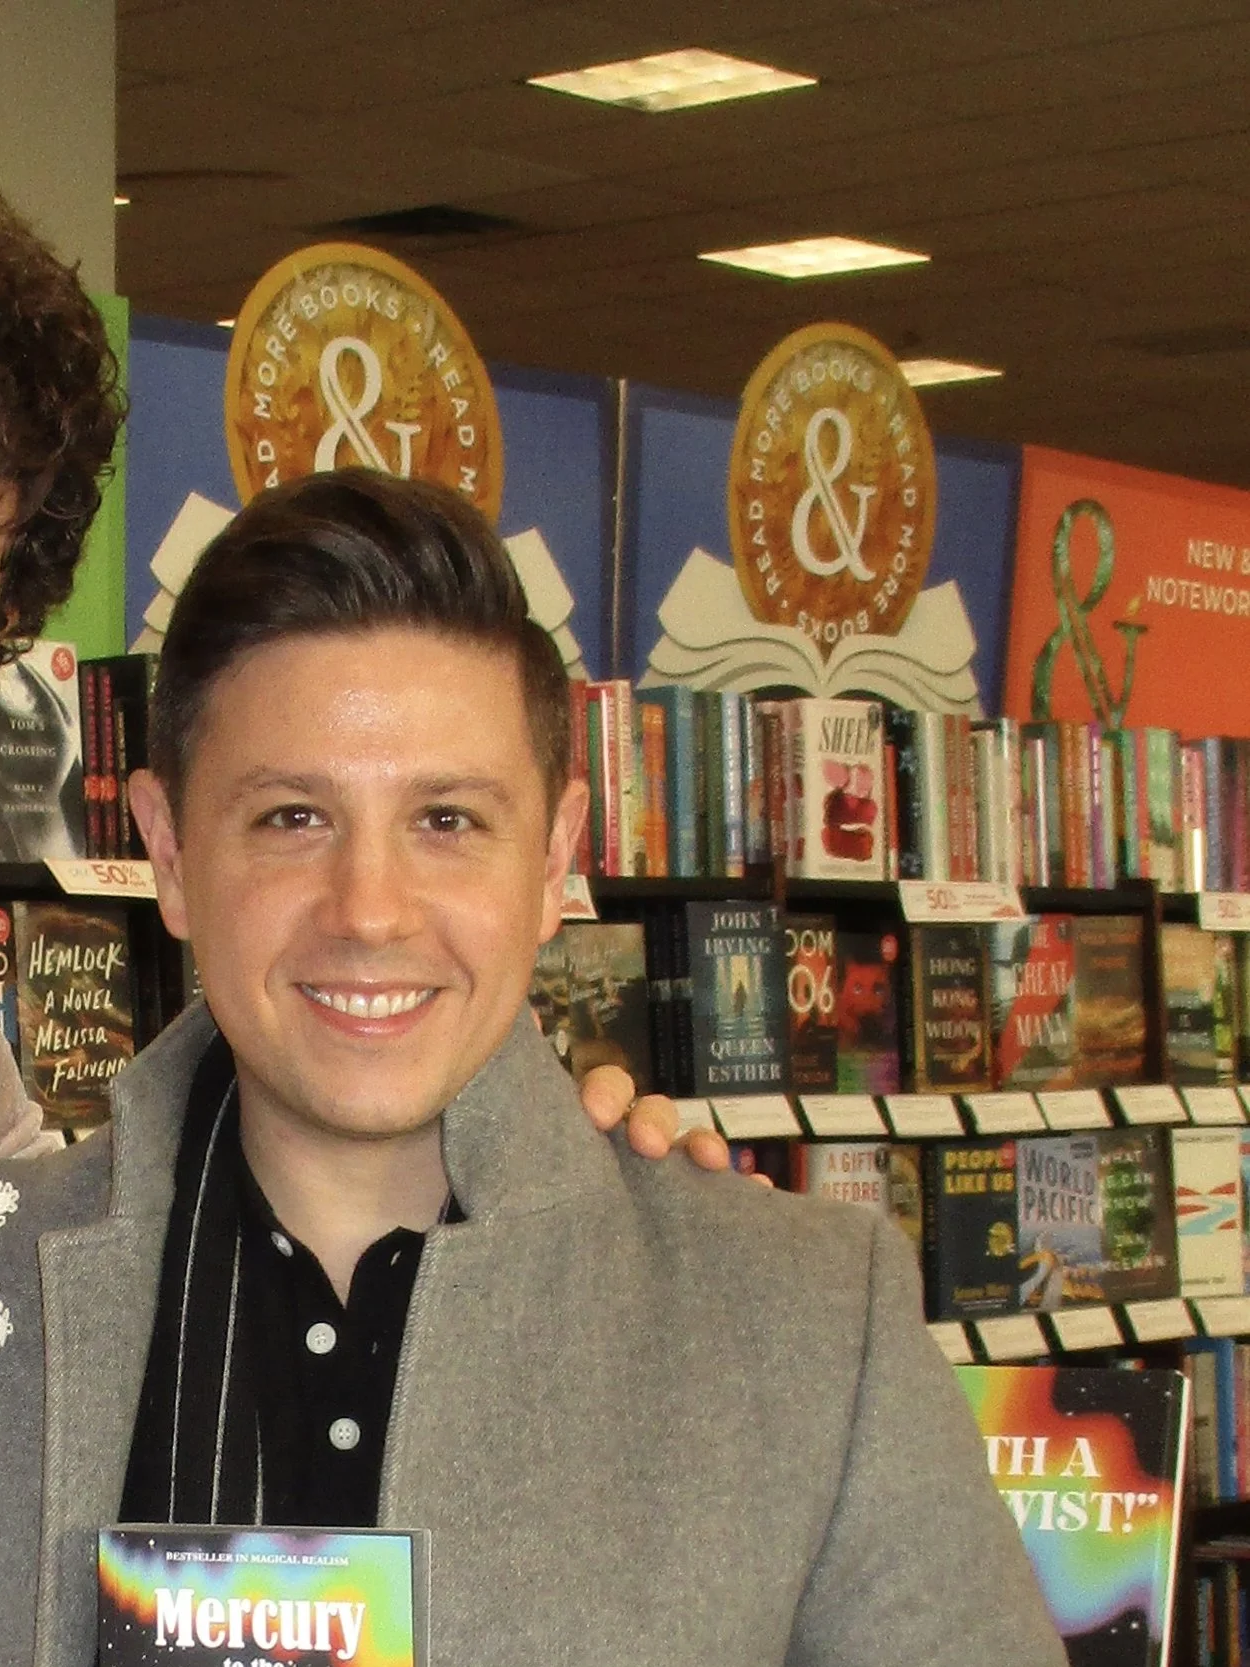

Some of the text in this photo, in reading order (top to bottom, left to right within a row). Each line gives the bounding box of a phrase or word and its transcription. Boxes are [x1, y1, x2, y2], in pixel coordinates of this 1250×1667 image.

[253, 284, 400, 419] MORE BOOKS
[791, 360, 874, 392] BOOKS
[429, 342, 474, 447] READ
[1187, 538, 1236, 572] NEW
[0, 745, 56, 758] CROSSING
[711, 911, 761, 931] JOHN
[28, 934, 125, 979] HEMLOCK
[705, 937, 770, 954] IRVING
[44, 986, 114, 1014] A NOVEL
[711, 1038, 775, 1060] QUEEN
[708, 1064, 781, 1082] ESTHER
[828, 1151, 876, 1173] A GIFT
[1022, 1146, 1095, 1196] WORLD
[944, 1172, 1015, 1194] LIKE US
[1023, 1186, 1097, 1224] PACIFIC
[1060, 1437, 1101, 1477] A
[166, 1552, 349, 1566] BESTSELLER IN MAGICAL REALISM
[154, 1588, 366, 1660] Mercury
